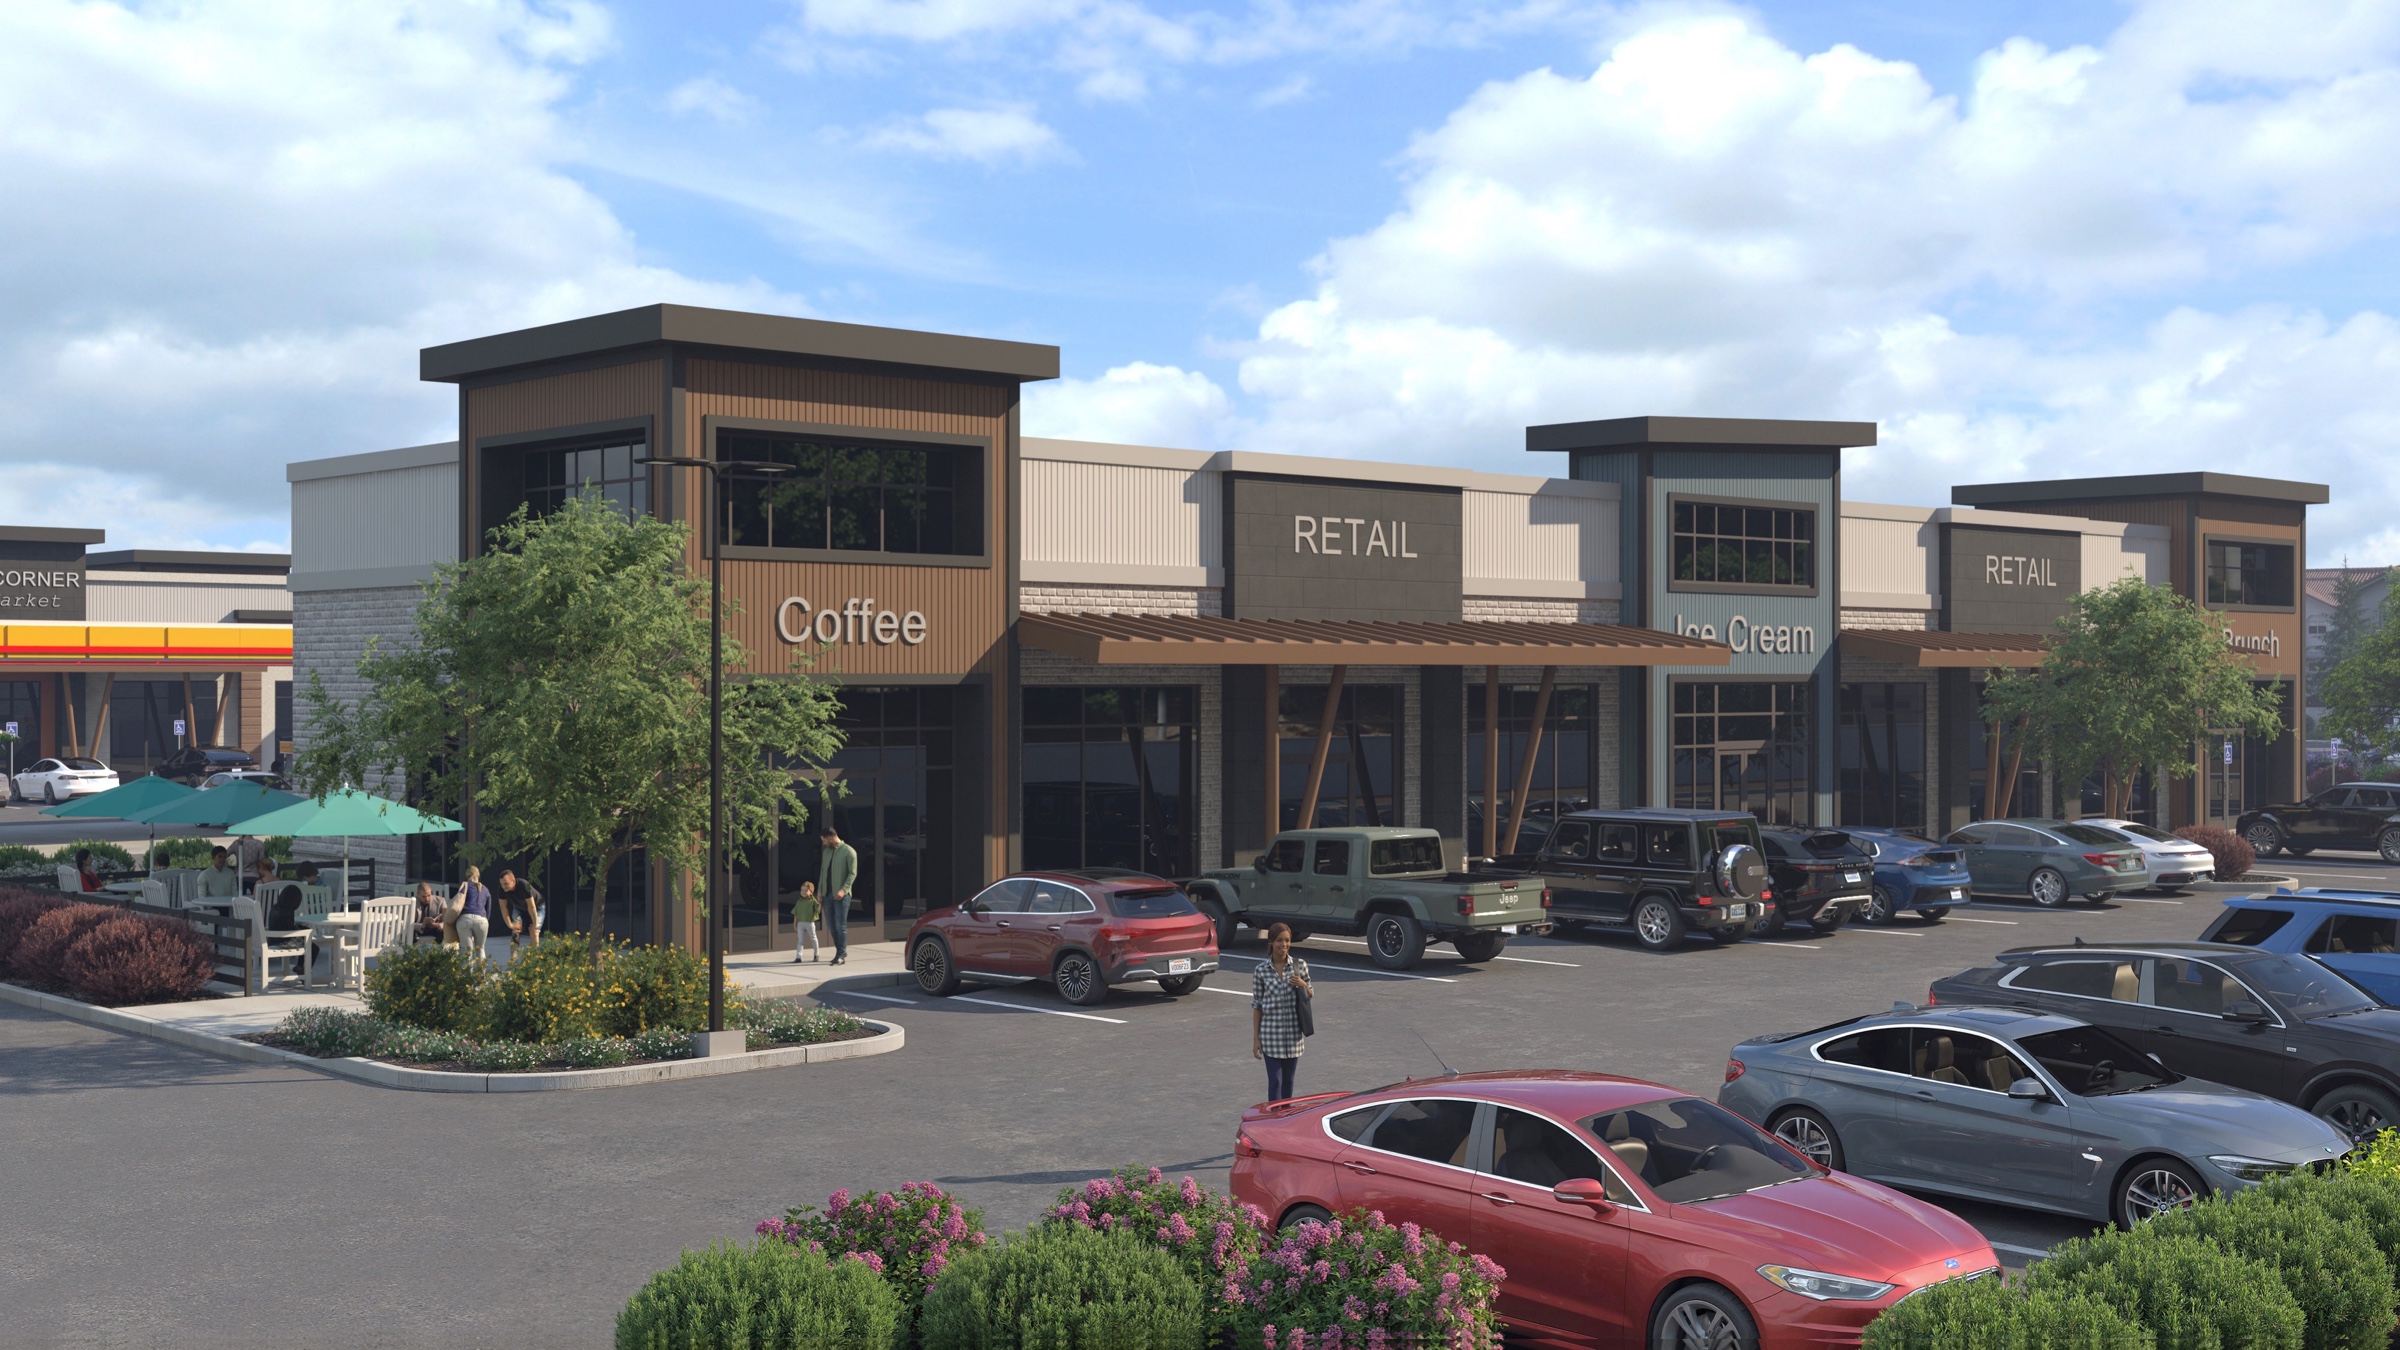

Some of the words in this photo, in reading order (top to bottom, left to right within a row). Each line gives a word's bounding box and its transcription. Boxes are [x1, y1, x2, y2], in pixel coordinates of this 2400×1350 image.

[1294, 515, 1418, 558] RETAIL
[1986, 555, 2057, 587] RETAIL
[0, 593, 61, 608] arket
[777, 596, 927, 645] Coffee
[1728, 615, 1814, 653] Cream
[1499, 893, 1519, 904] Jeep
